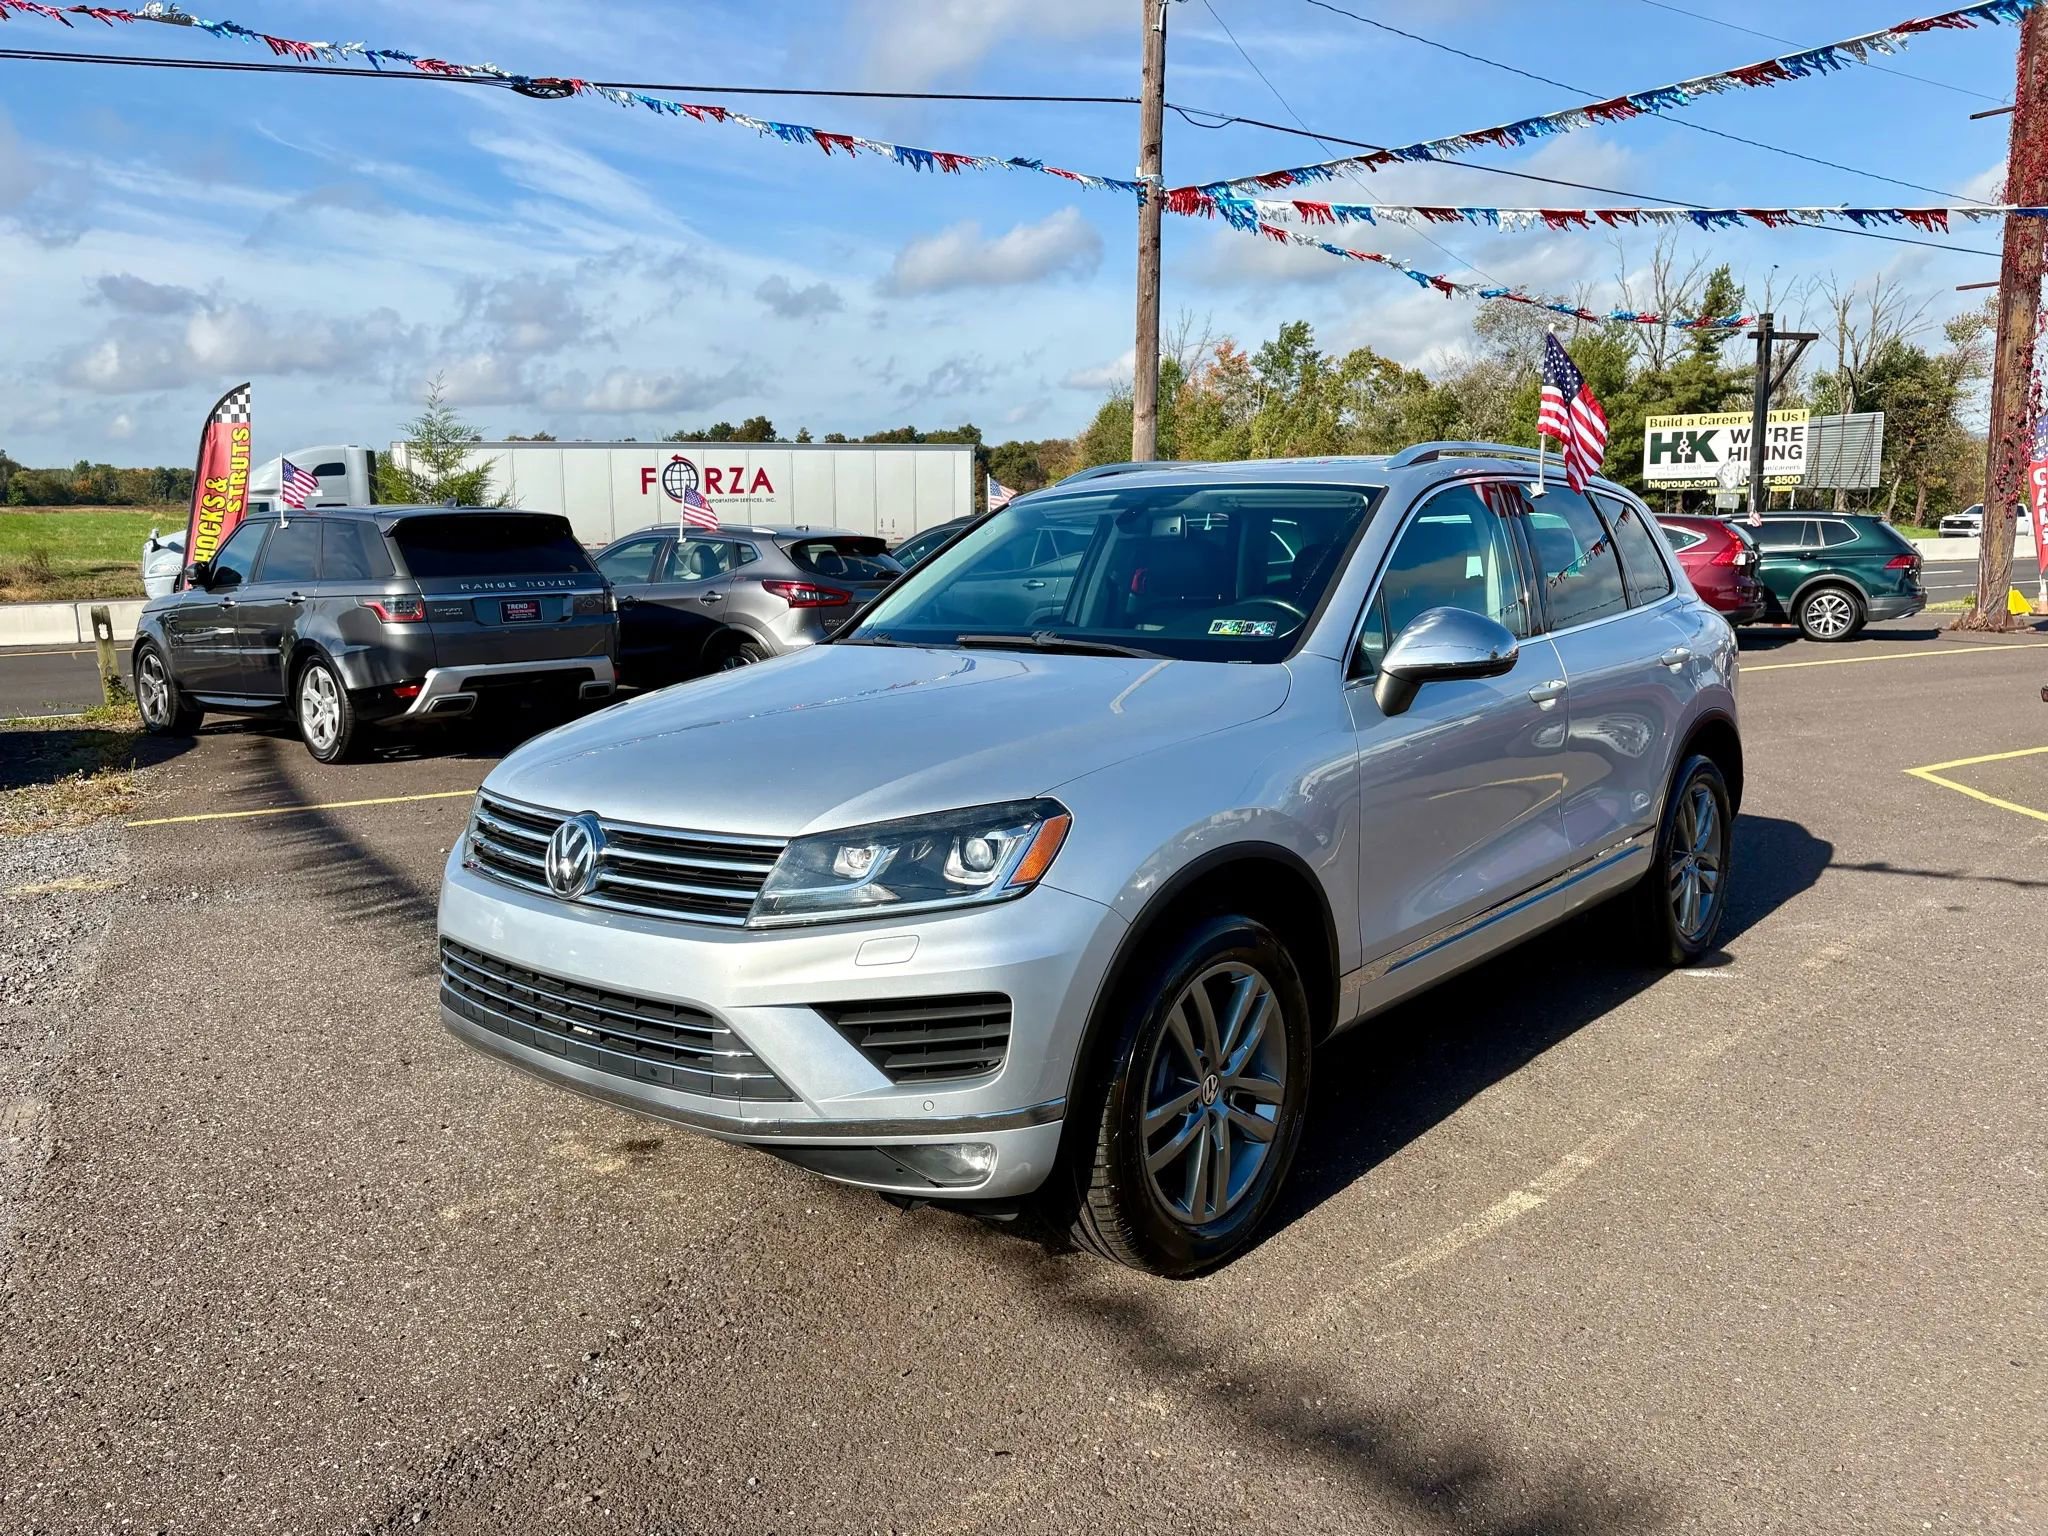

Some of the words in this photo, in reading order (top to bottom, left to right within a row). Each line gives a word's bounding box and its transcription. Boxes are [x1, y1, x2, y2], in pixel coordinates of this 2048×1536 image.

[1649, 417, 1683, 428] Build
[1687, 418, 1694, 426] a
[1699, 414, 1743, 426] Career
[1748, 412, 1777, 424] wh
[1730, 426, 1804, 444] W'RE
[1649, 429, 1720, 465] H&K
[1728, 444, 1803, 462] HIING
[226, 427, 250, 514] STRUTS
[205, 476, 229, 494] &
[1648, 478, 1718, 490] hkgroup.com
[193, 494, 226, 563] HOCKS
[460, 581, 517, 591] RANGE
[526, 579, 577, 588] ROVER
